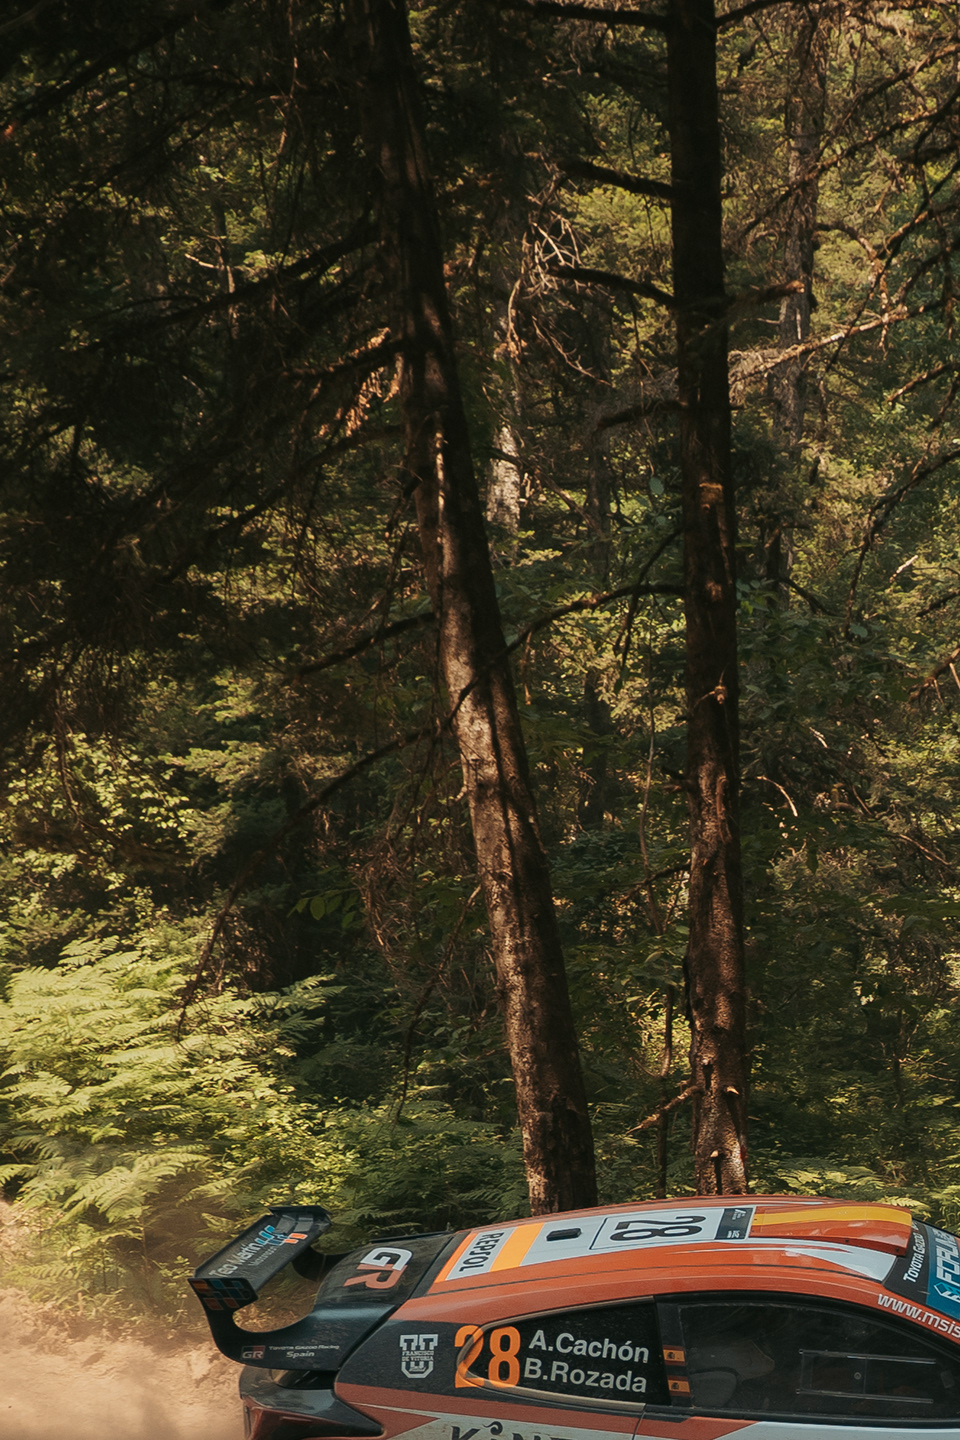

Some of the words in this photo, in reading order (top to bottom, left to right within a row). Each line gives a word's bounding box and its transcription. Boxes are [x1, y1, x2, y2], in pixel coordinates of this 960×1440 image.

[610, 1214, 707, 1242] 28
[340, 1247, 413, 1290] GR
[903, 1253, 925, 1284] TOYOTA
[286, 1350, 315, 1359] Spain
[454, 1325, 521, 1389] 28
[529, 1329, 650, 1364] A.Cachón
[523, 1357, 648, 1394] B.Rozada
